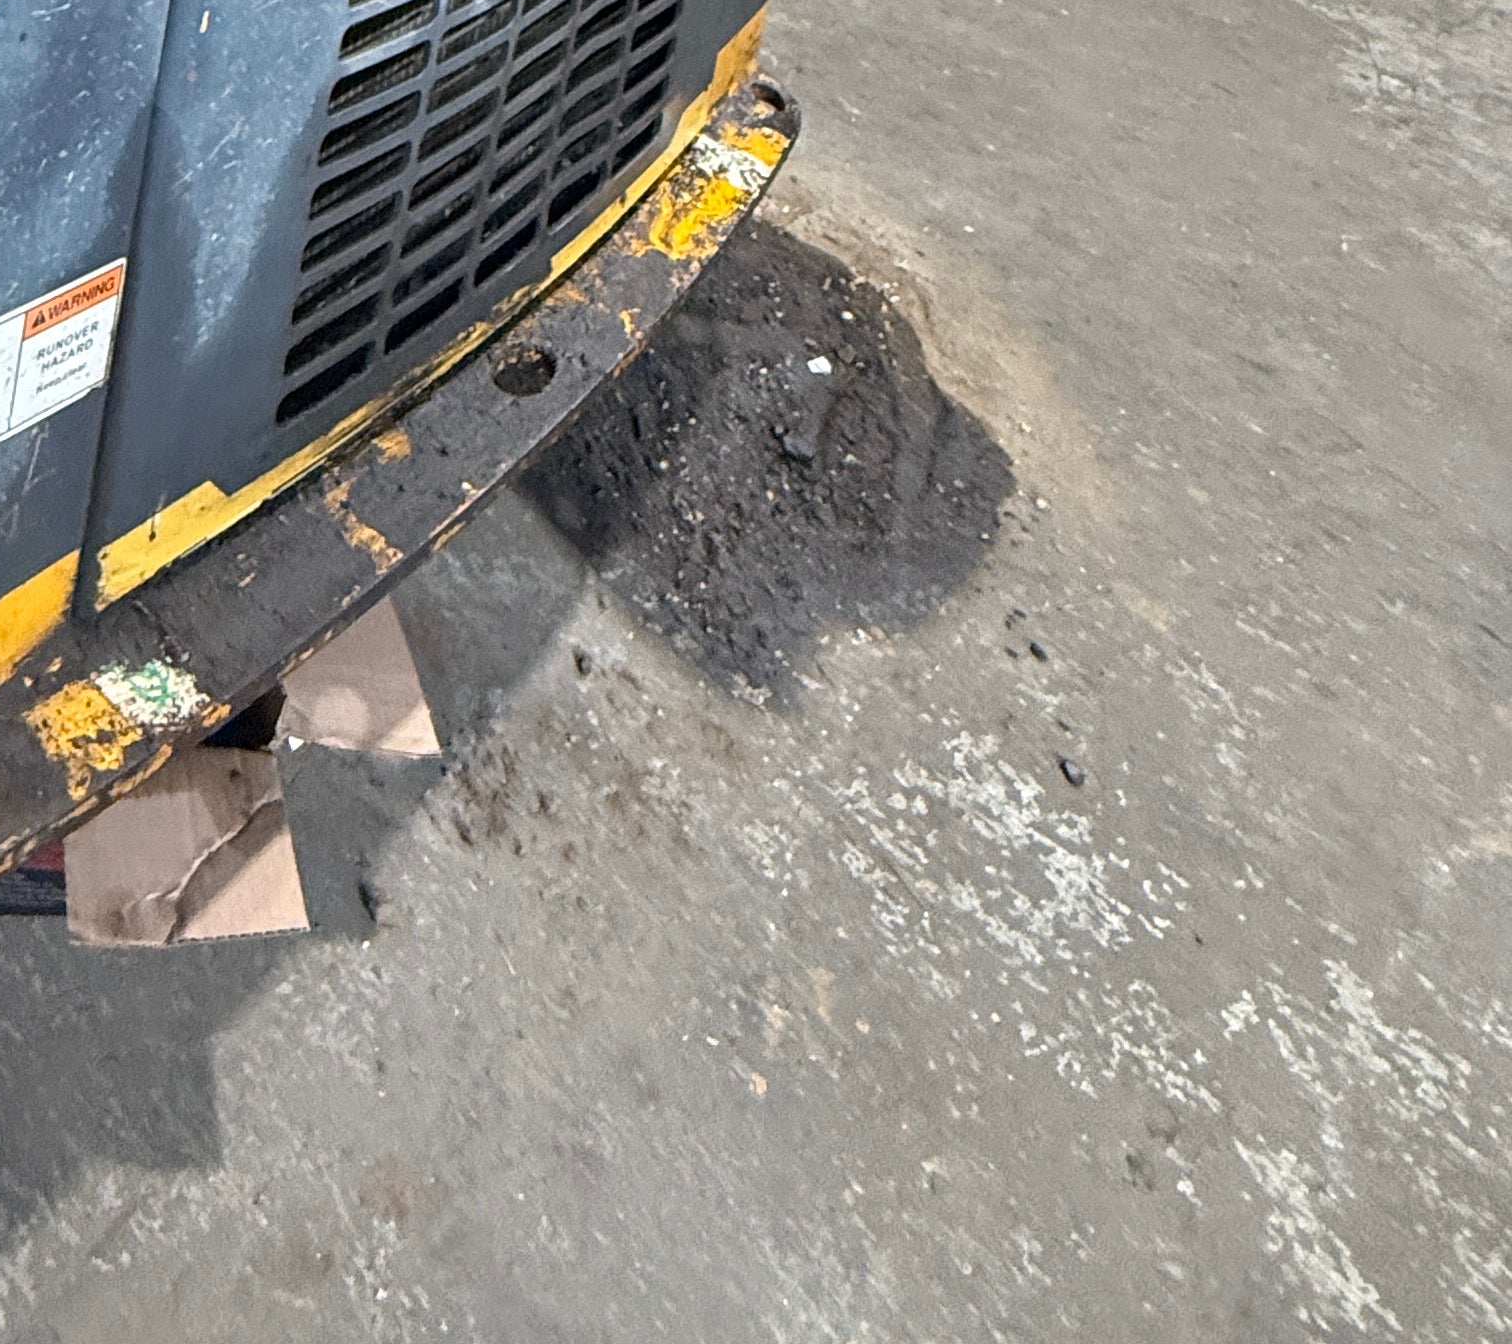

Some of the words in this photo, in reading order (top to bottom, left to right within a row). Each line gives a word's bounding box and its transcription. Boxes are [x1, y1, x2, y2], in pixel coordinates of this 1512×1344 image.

[48, 277, 115, 319] WARNING
[36, 321, 99, 360] RUNOVER
[41, 338, 93, 373] HAZARD
